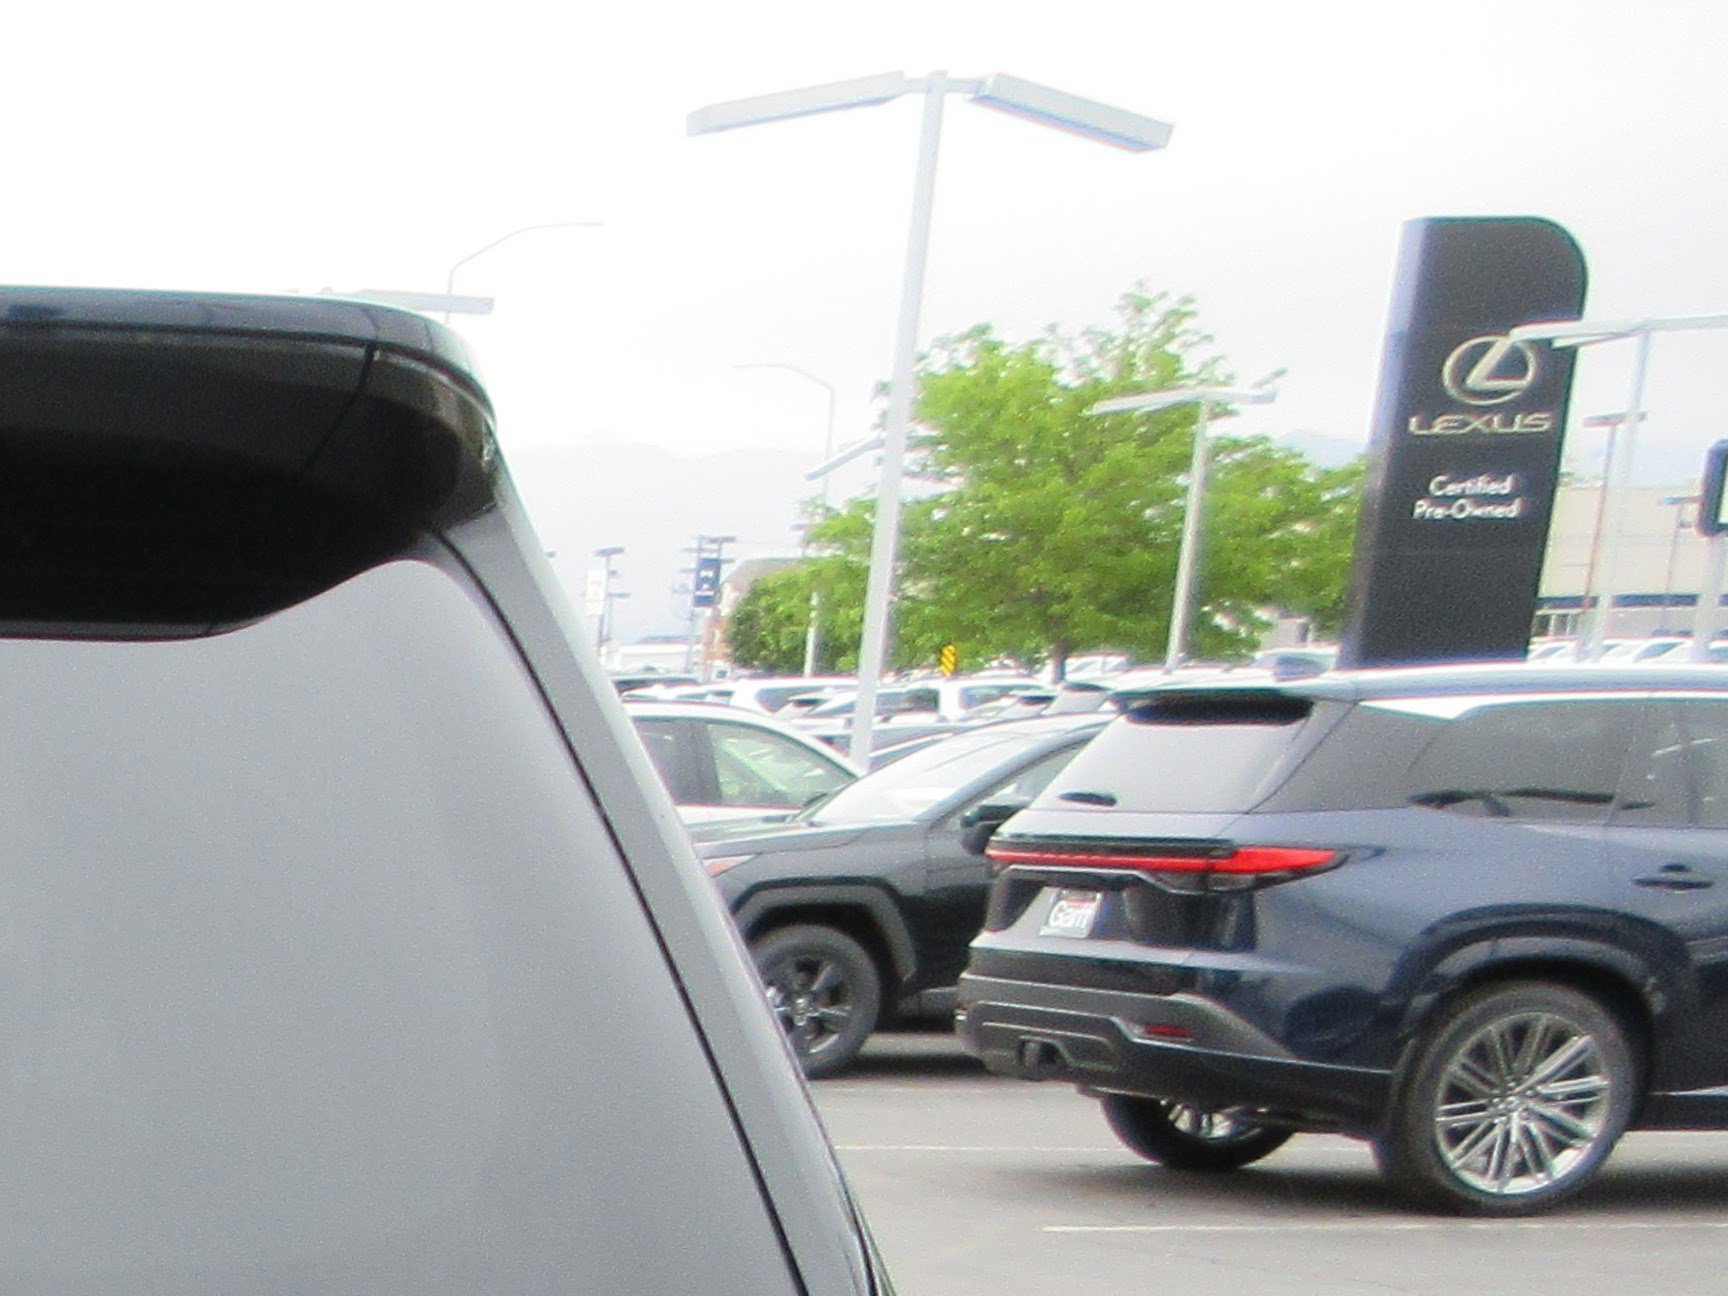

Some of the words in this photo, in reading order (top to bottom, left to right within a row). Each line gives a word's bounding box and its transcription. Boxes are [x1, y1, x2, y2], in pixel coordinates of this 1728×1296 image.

[1409, 411, 1553, 435] LEXUS
[1428, 474, 1516, 496] Certified
[1413, 498, 1522, 519] Pre-Owned
